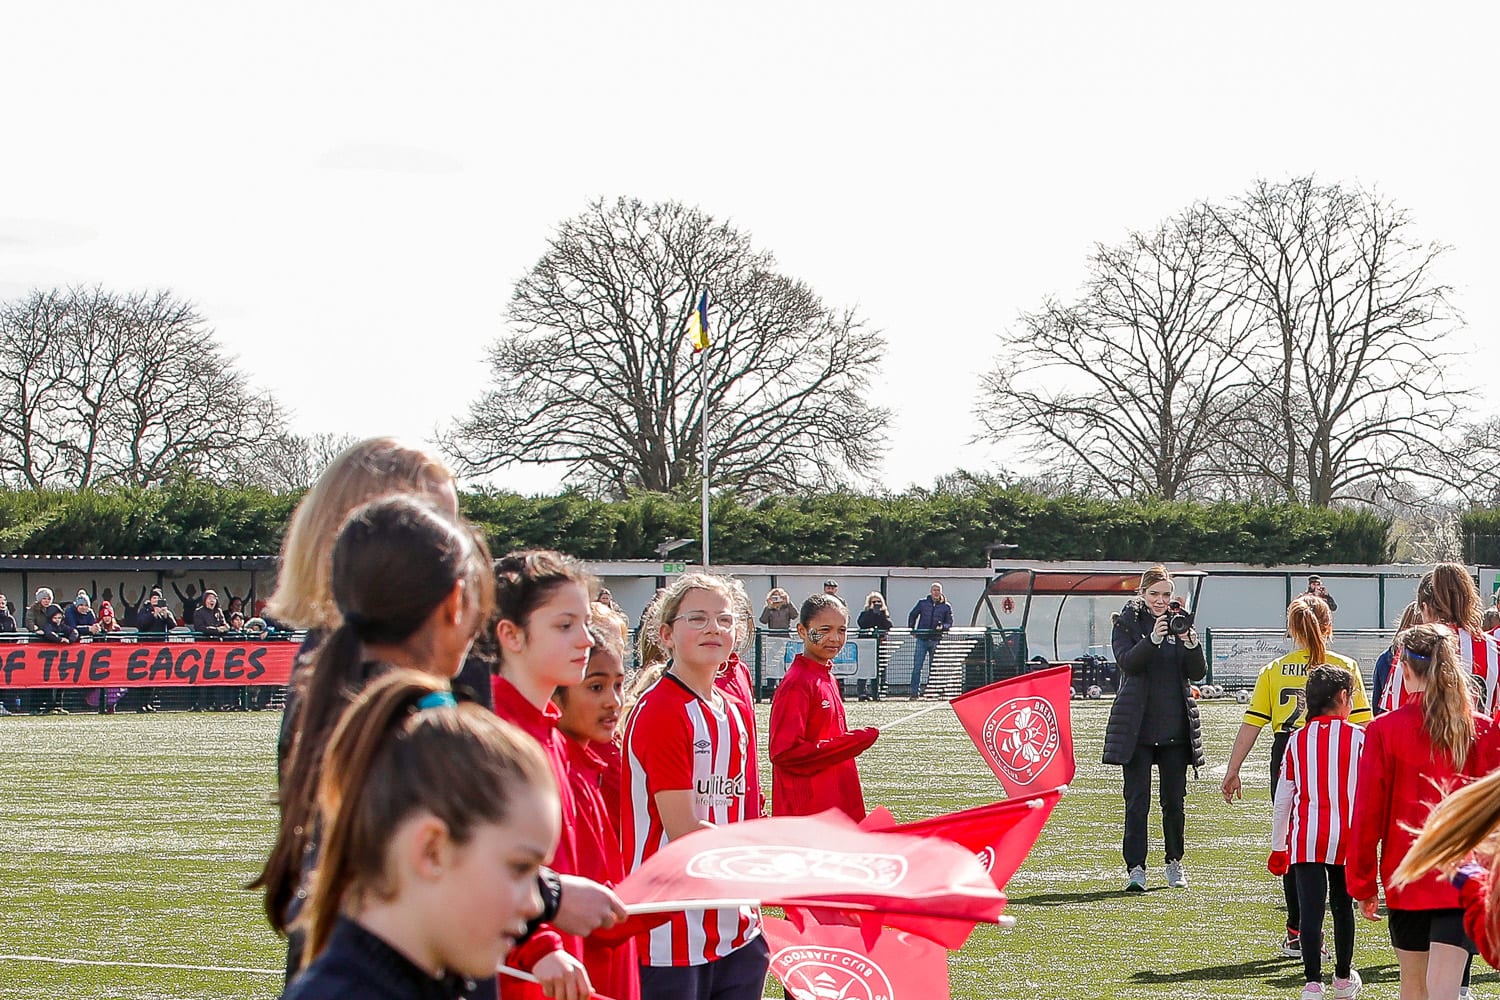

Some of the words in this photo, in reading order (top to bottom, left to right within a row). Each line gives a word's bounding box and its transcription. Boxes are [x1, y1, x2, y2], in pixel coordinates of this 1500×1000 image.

[38, 648, 111, 683] THE
[126, 647, 267, 684] EAGLES
[1034, 701, 1058, 758] BRENTFORD
